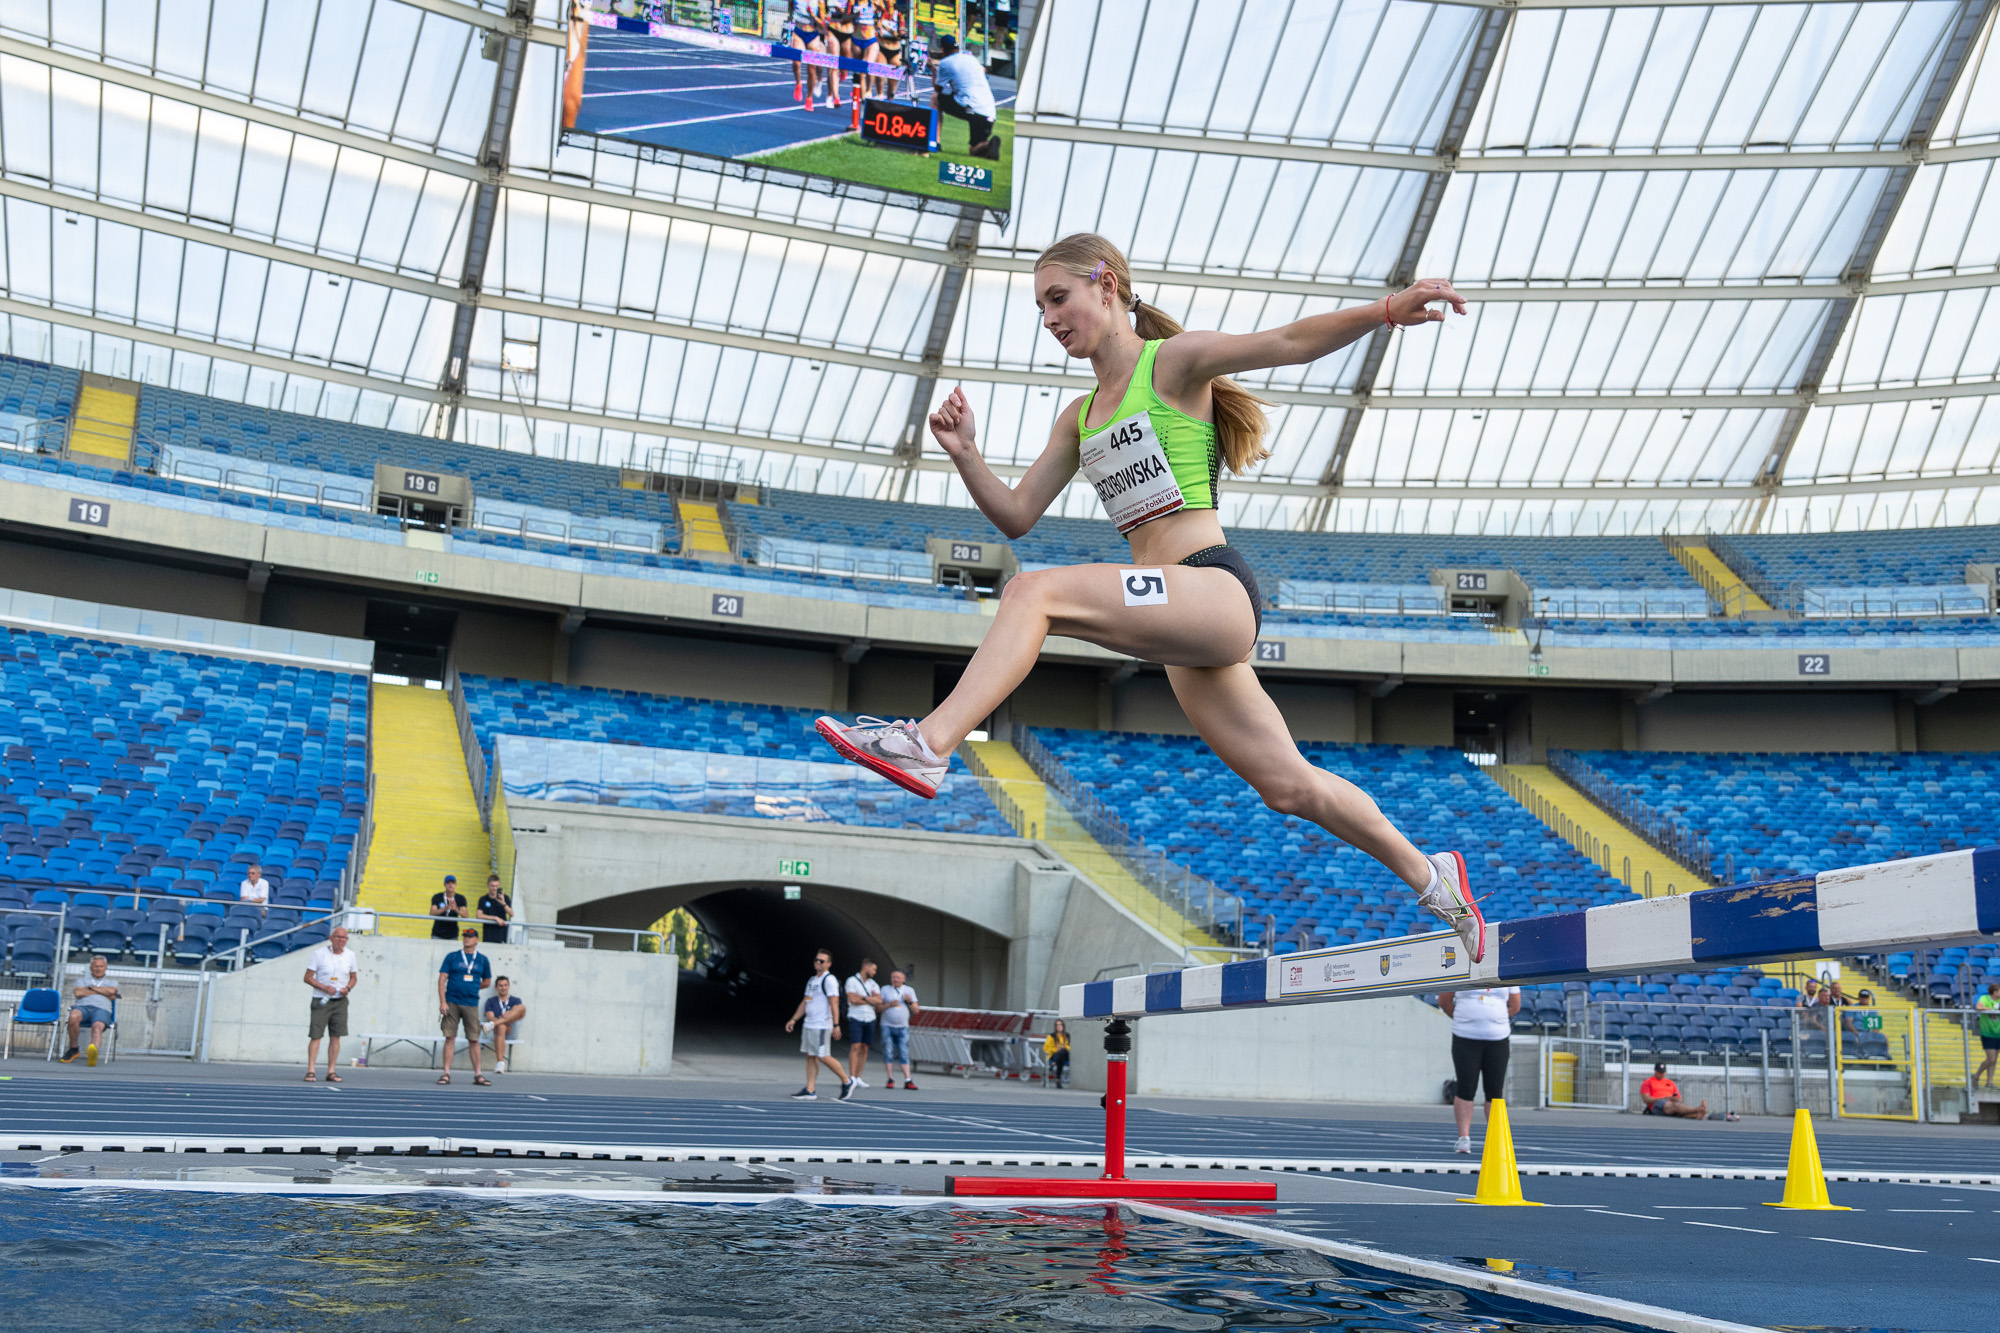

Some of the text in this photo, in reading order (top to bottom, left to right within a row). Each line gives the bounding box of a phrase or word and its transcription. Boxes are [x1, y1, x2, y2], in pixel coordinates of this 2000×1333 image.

[864, 113, 927, 138] -0.8m/s
[947, 163, 986, 180] 3:27.0
[1110, 421, 1143, 451] 445
[407, 474, 437, 493] 19 G
[1145, 495, 1166, 510] Polski
[1165, 489, 1180, 501] U18
[77, 502, 102, 523] 19
[953, 545, 980, 561] 20 G
[1126, 575, 1164, 597] 5
[1459, 574, 1485, 589] 21 G
[717, 596, 738, 615] 20
[1261, 642, 1280, 660] 21
[1804, 656, 1825, 673] 22
[1867, 1017, 1879, 1029] 31
